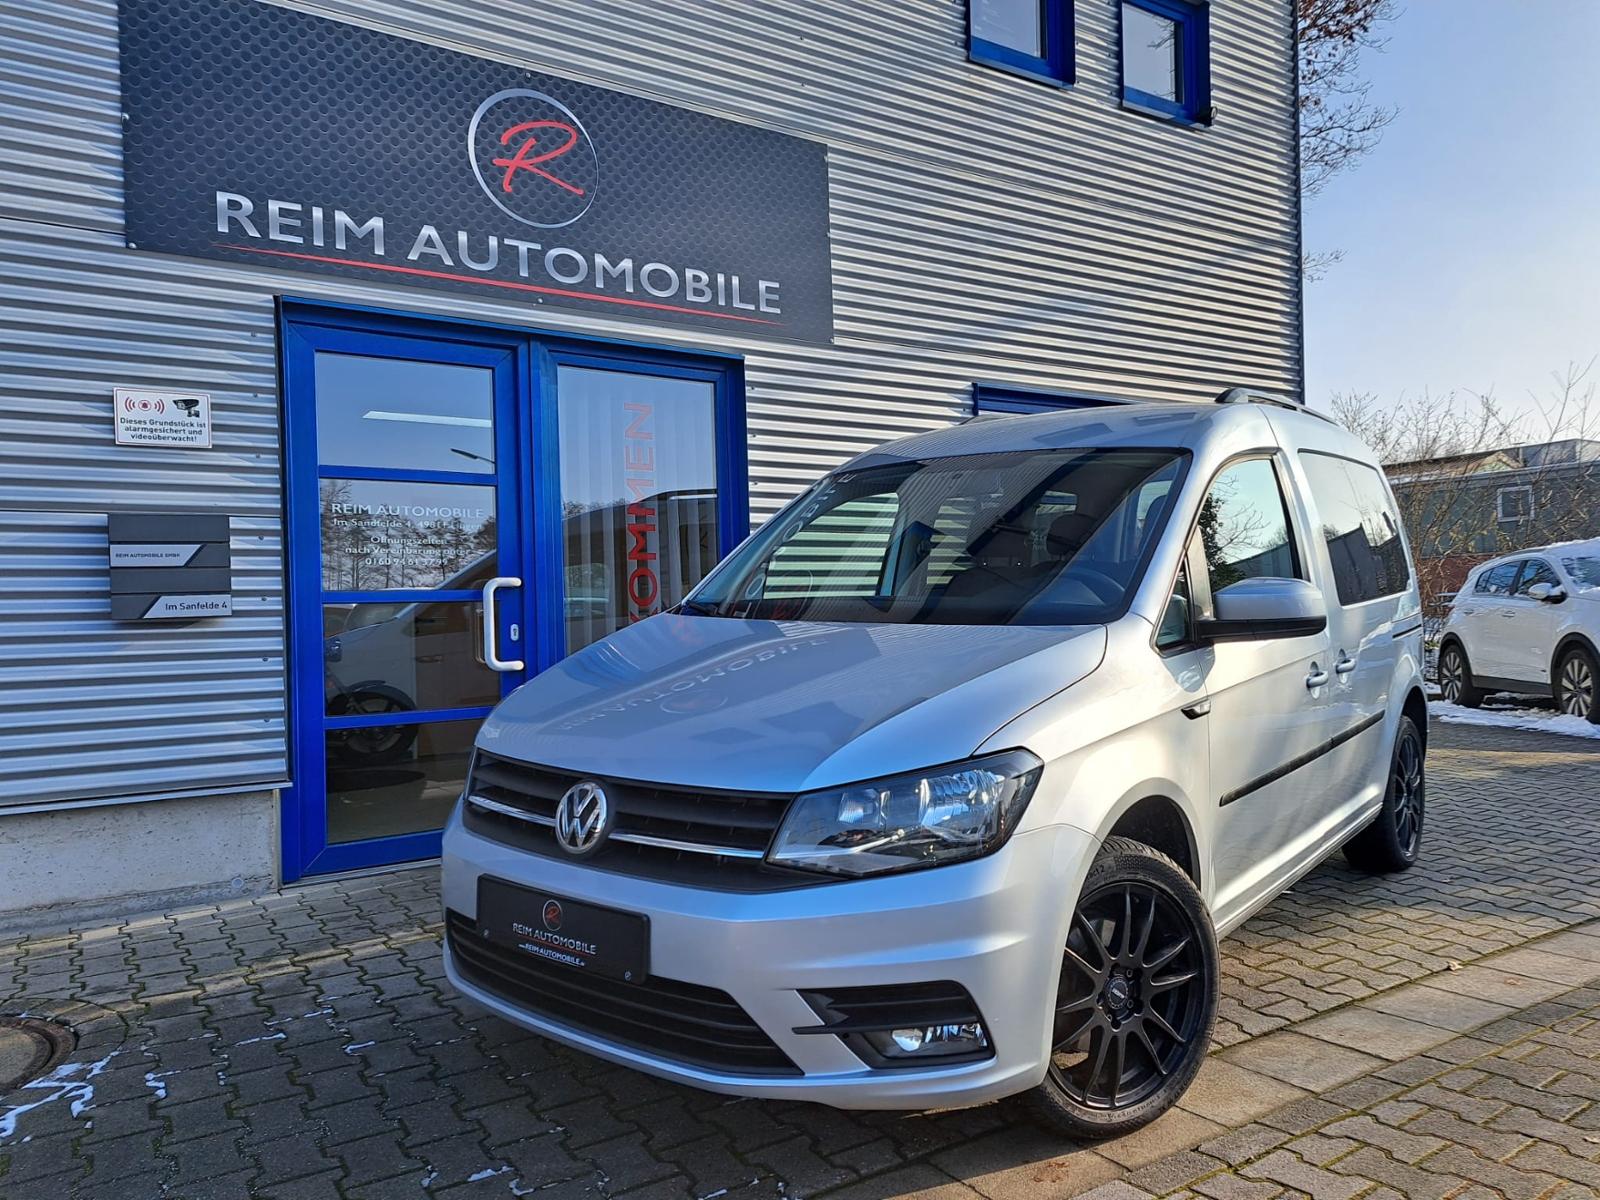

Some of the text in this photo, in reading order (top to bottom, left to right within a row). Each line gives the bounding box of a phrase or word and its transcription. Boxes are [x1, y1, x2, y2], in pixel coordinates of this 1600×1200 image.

[492, 119, 585, 197] R
[215, 190, 782, 314] REIM AUTOMOBILE
[120, 417, 207, 429] Dieses Grundstück ist
[124, 425, 203, 436] alarmgesichert und
[130, 433, 197, 442] videoüberwacht!
[331, 503, 485, 519] REIM AUTOMOBILE
[333, 518, 348, 526] Im
[345, 546, 371, 555] nach
[372, 546, 442, 557] Vereinbarung
[365, 557, 391, 566] 0160
[165, 601, 228, 611] Im Sanfelde 4
[555, 782, 607, 854] VW
[512, 922, 597, 955] REIM AUTOMOBILE
